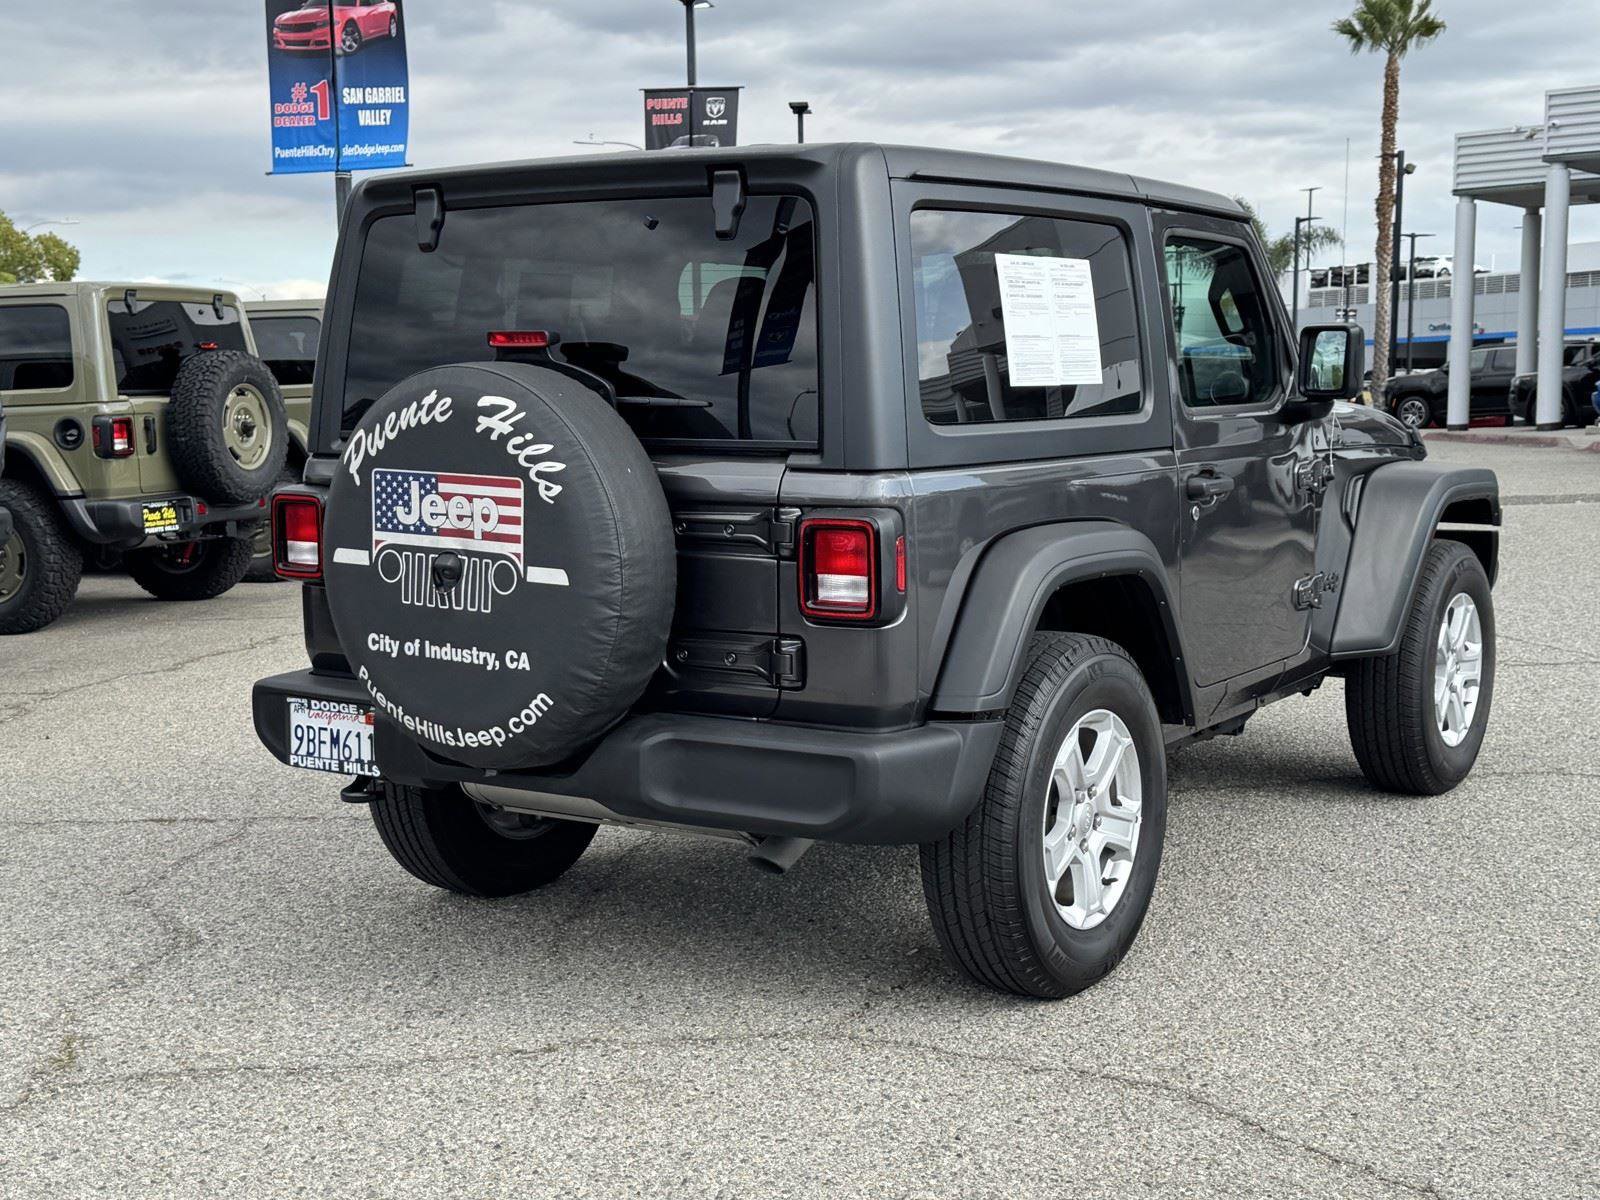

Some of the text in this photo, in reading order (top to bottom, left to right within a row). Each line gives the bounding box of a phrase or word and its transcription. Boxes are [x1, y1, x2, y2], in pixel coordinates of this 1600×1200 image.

[342, 86, 405, 104] SAN GABRIEL
[646, 97, 688, 110] PUENTE
[274, 102, 314, 114] DODGE
[274, 115, 316, 127] DEALER
[358, 109, 391, 126] VALLEY
[652, 113, 683, 126] HILLS
[343, 389, 567, 505] Puente Hills
[394, 480, 499, 540] Jeep
[367, 632, 531, 671] City of Industry, CA
[310, 699, 358, 715] DODGE
[358, 664, 554, 749] PuenteHillsJeep.com
[294, 723, 374, 762] 9BFM611
[289, 754, 381, 777] PUENTE HILLS
